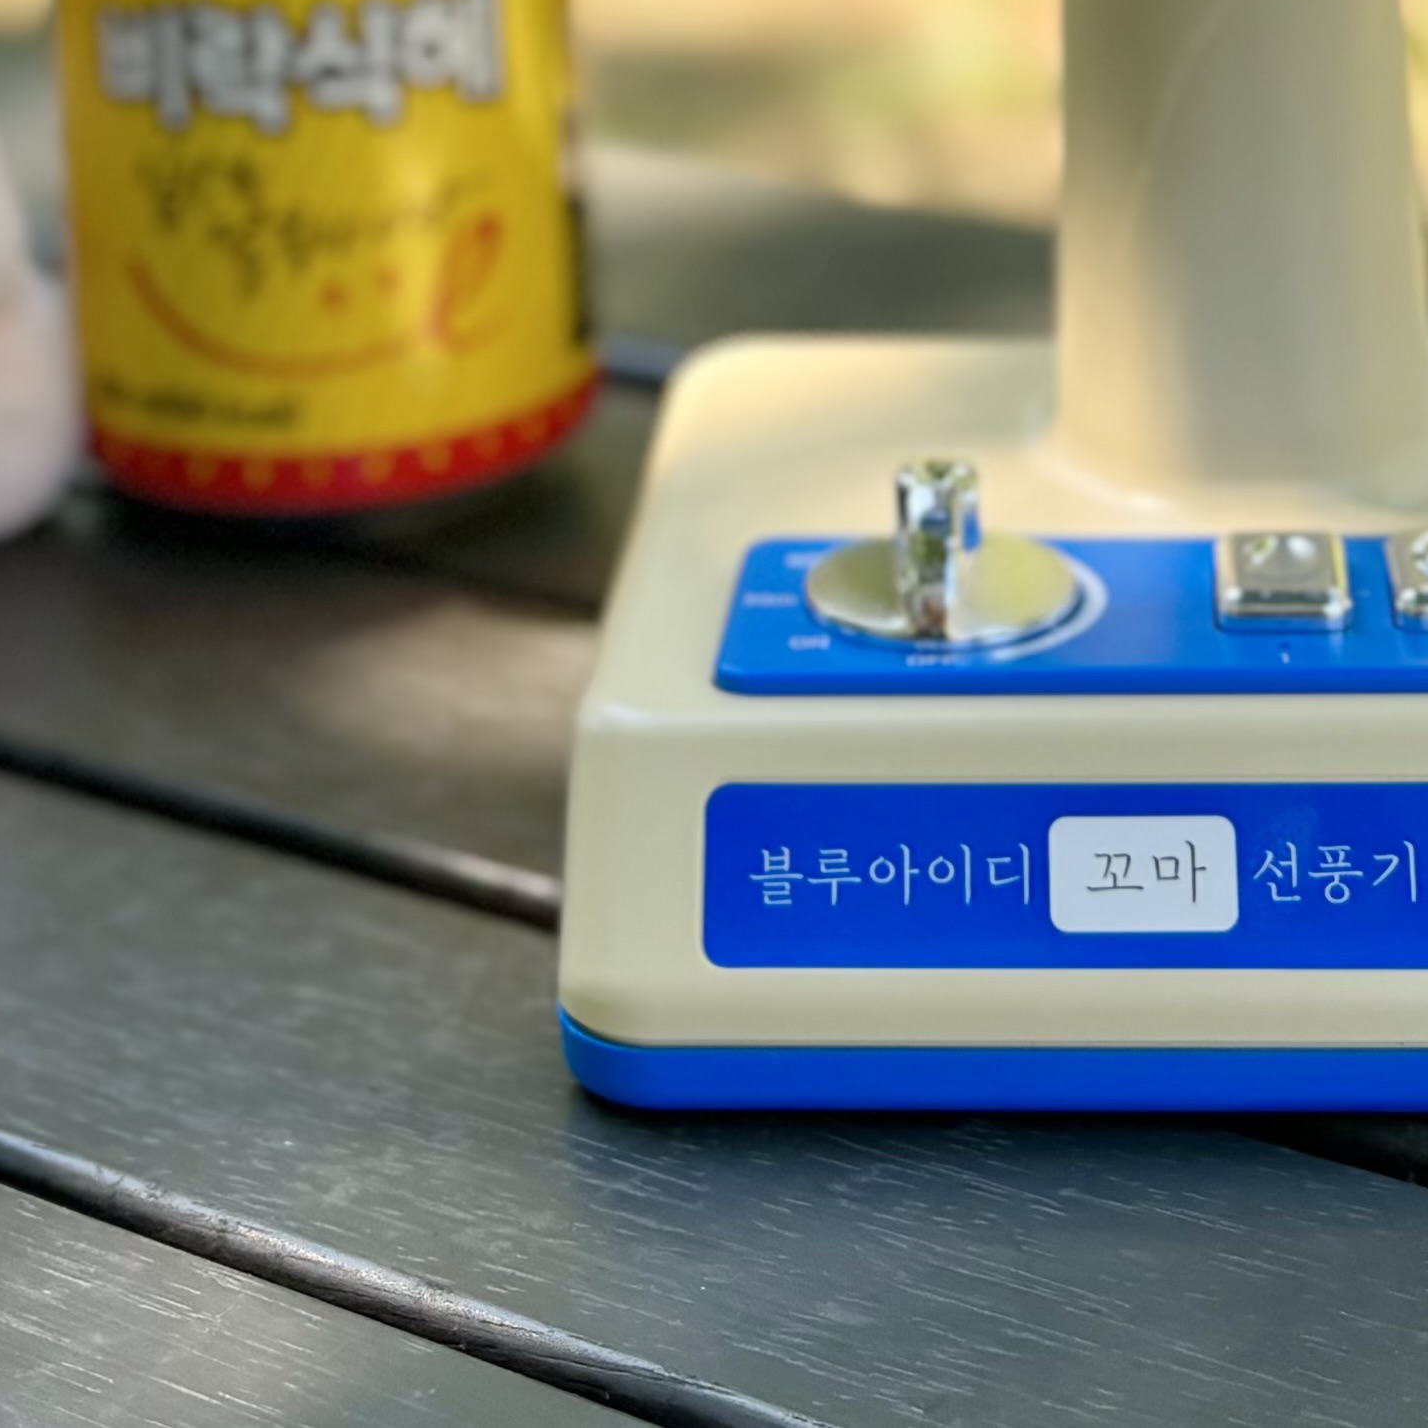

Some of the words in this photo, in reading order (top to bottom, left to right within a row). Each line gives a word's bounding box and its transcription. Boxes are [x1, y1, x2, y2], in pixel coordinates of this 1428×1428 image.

[749, 842, 1031, 907] 블루아이디
[1086, 840, 1207, 904] 꼬마
[1253, 840, 1418, 905] 선풍기
